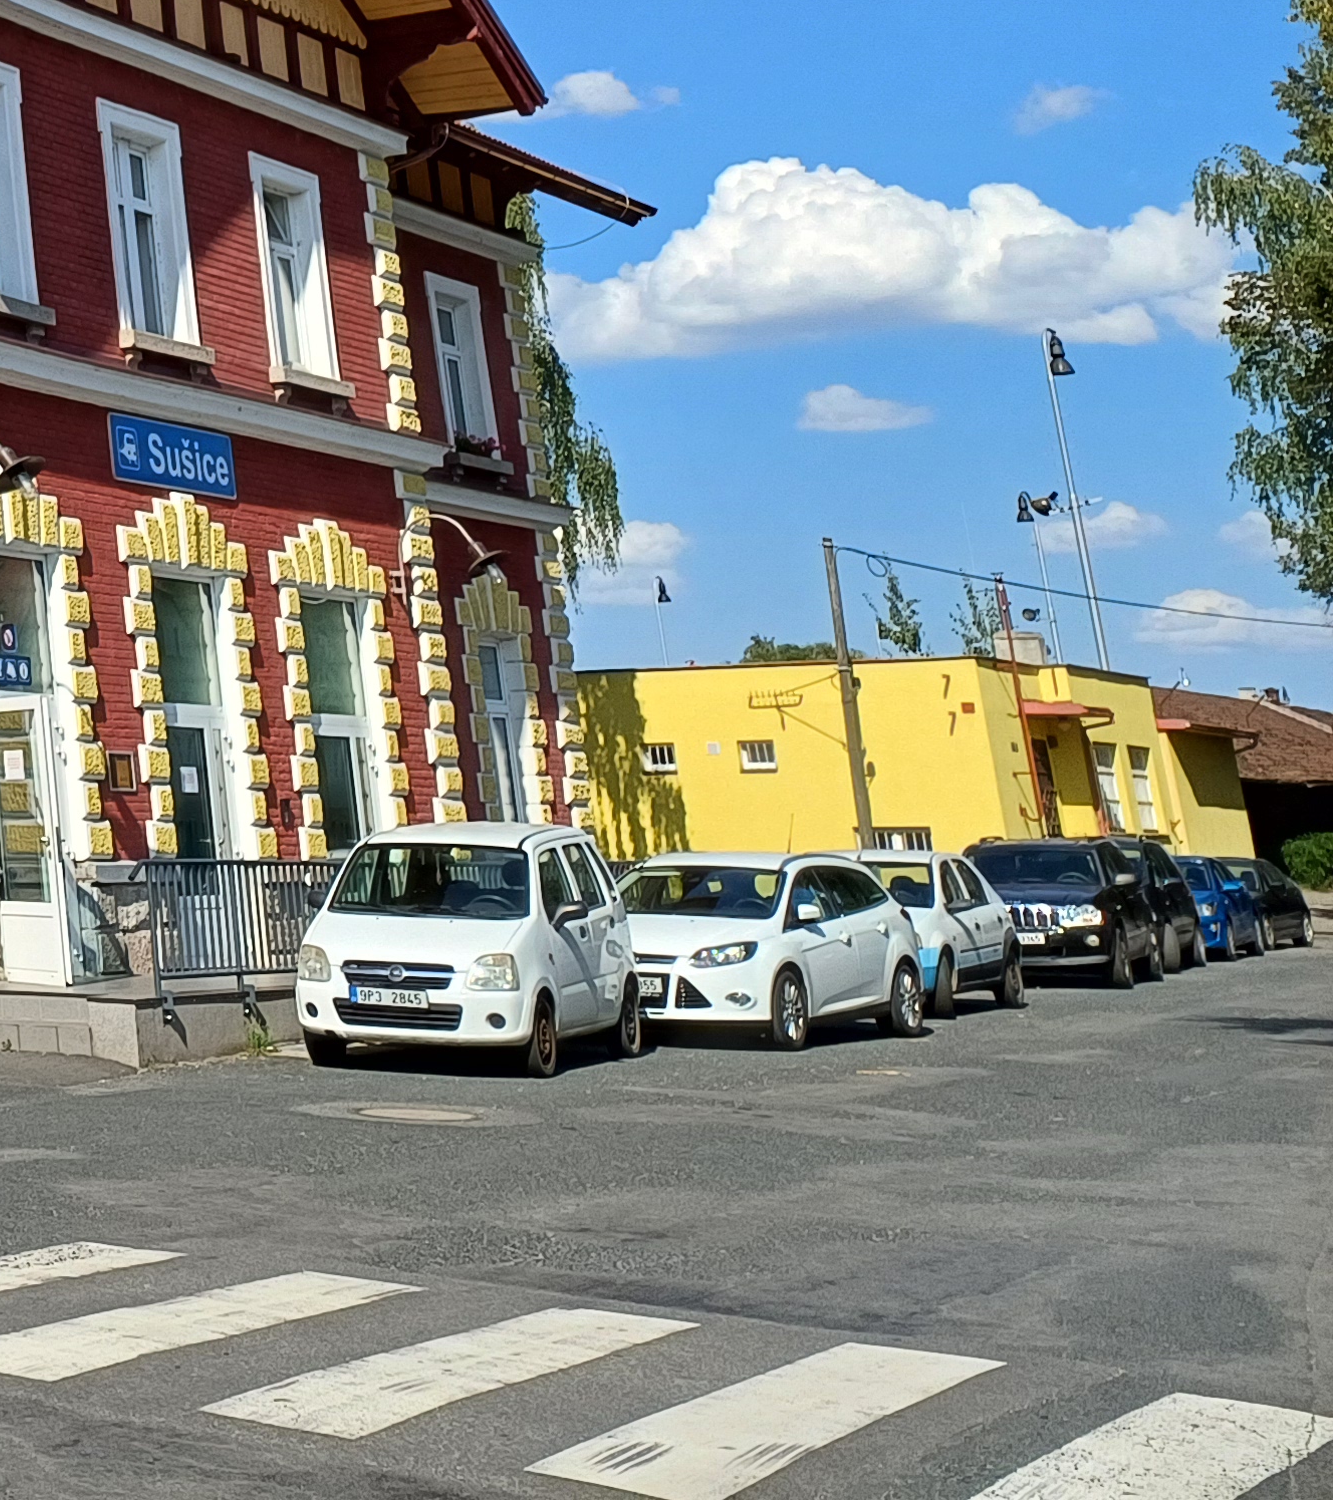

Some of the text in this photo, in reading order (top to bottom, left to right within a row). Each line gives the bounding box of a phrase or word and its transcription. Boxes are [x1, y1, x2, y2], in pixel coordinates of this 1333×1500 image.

[147, 432, 230, 487] Sušice
[359, 989, 382, 1003] 9P3
[391, 991, 422, 1006] 2845
